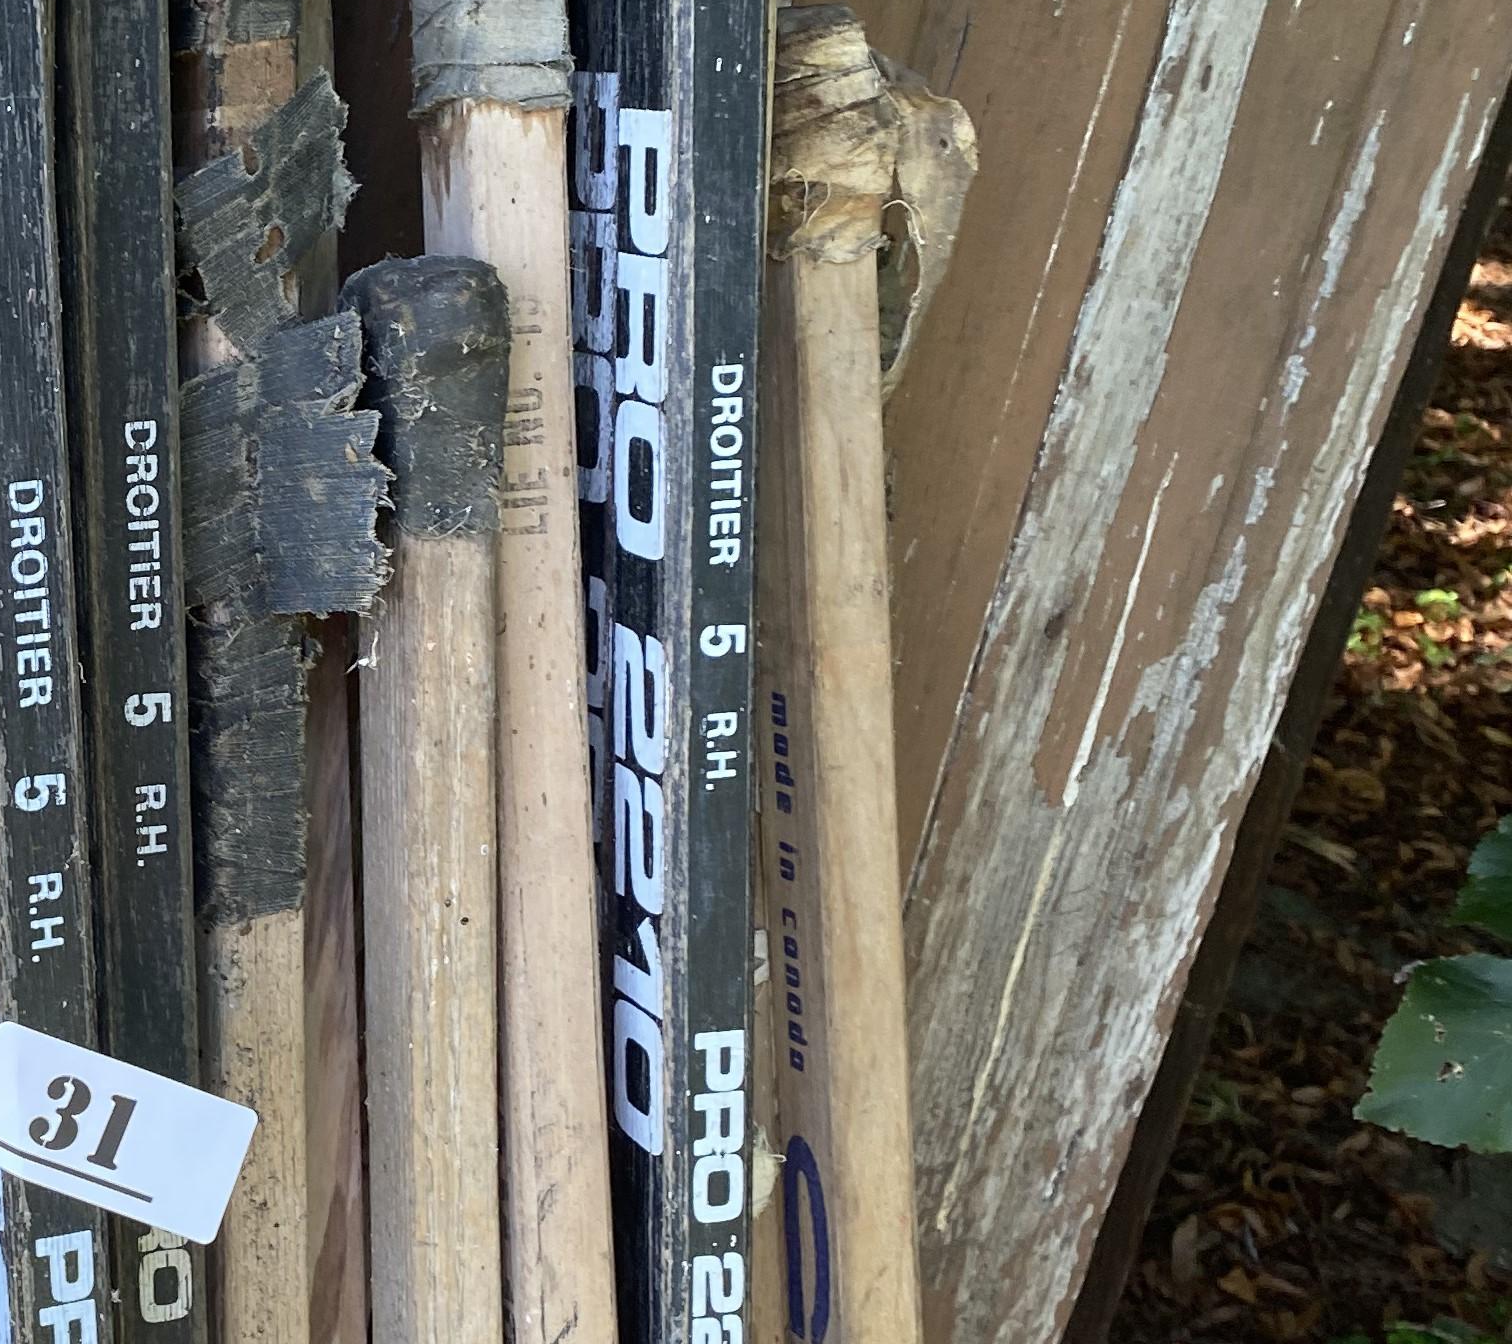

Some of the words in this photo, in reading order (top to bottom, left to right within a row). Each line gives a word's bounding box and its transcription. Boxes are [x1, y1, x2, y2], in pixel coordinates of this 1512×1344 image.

[614, 108, 671, 560] PRO
[709, 362, 745, 567] DROITIER
[124, 419, 164, 632] DROITIER
[7, 479, 52, 709] DROITIER
[698, 622, 746, 658] 5
[123, 692, 173, 728] 5
[705, 711, 737, 791] R.H.
[14, 772, 66, 812] 5
[134, 783, 167, 867] R.H.
[613, 622, 668, 1156] 2210
[778, 840, 800, 882] in
[27, 871, 64, 963] R.H.
[29, 1074, 138, 1171] 31
[690, 1030, 746, 1224] PRO
